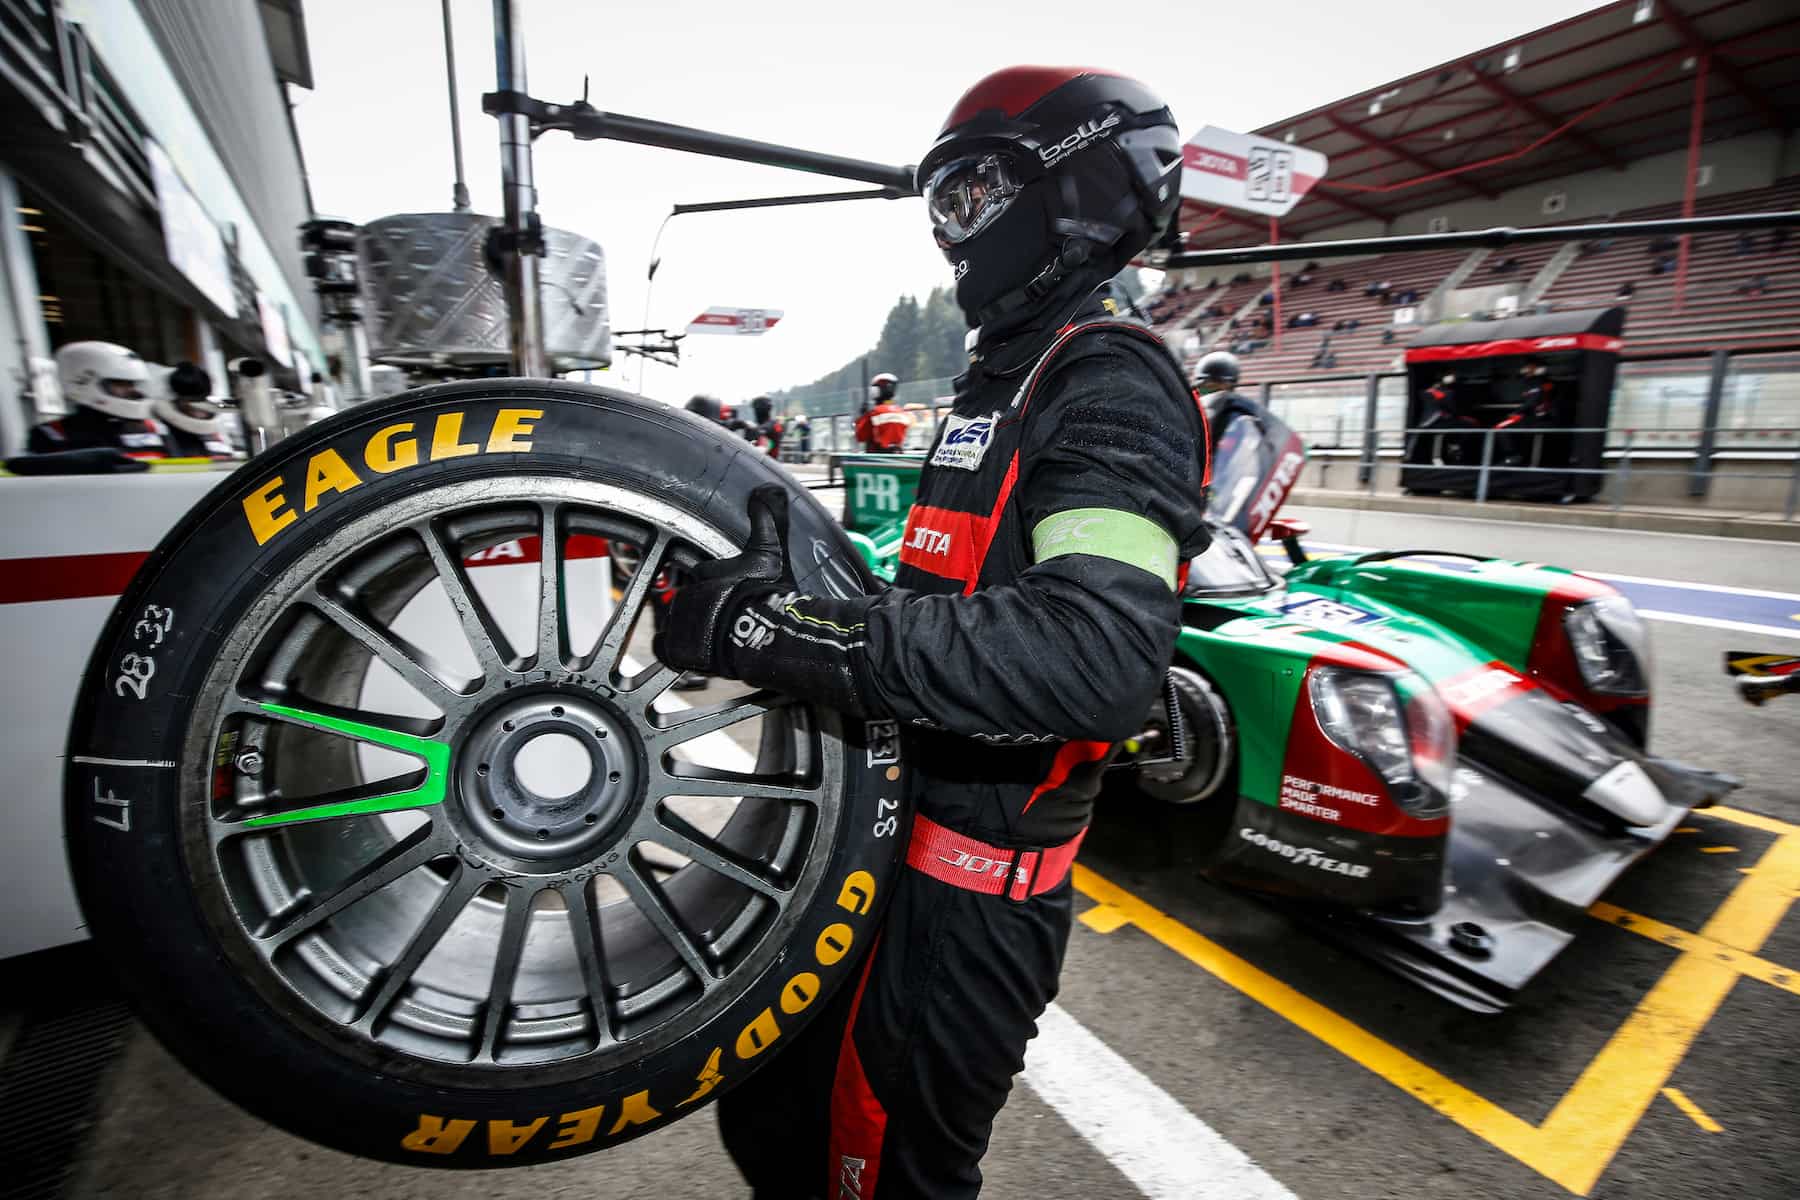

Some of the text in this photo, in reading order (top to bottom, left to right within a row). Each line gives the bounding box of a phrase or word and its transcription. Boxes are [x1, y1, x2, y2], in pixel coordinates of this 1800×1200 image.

[241, 408, 545, 547] EAGLE
[1249, 452, 1304, 535] JOTA
[904, 526, 952, 557] JOTA
[872, 797, 898, 838] 28
[1280, 797, 1341, 821] SMARTER
[1281, 787, 1318, 804] MADE
[1239, 827, 1372, 879] GOODYEAR
[401, 869, 876, 1155] GOODYEAR
